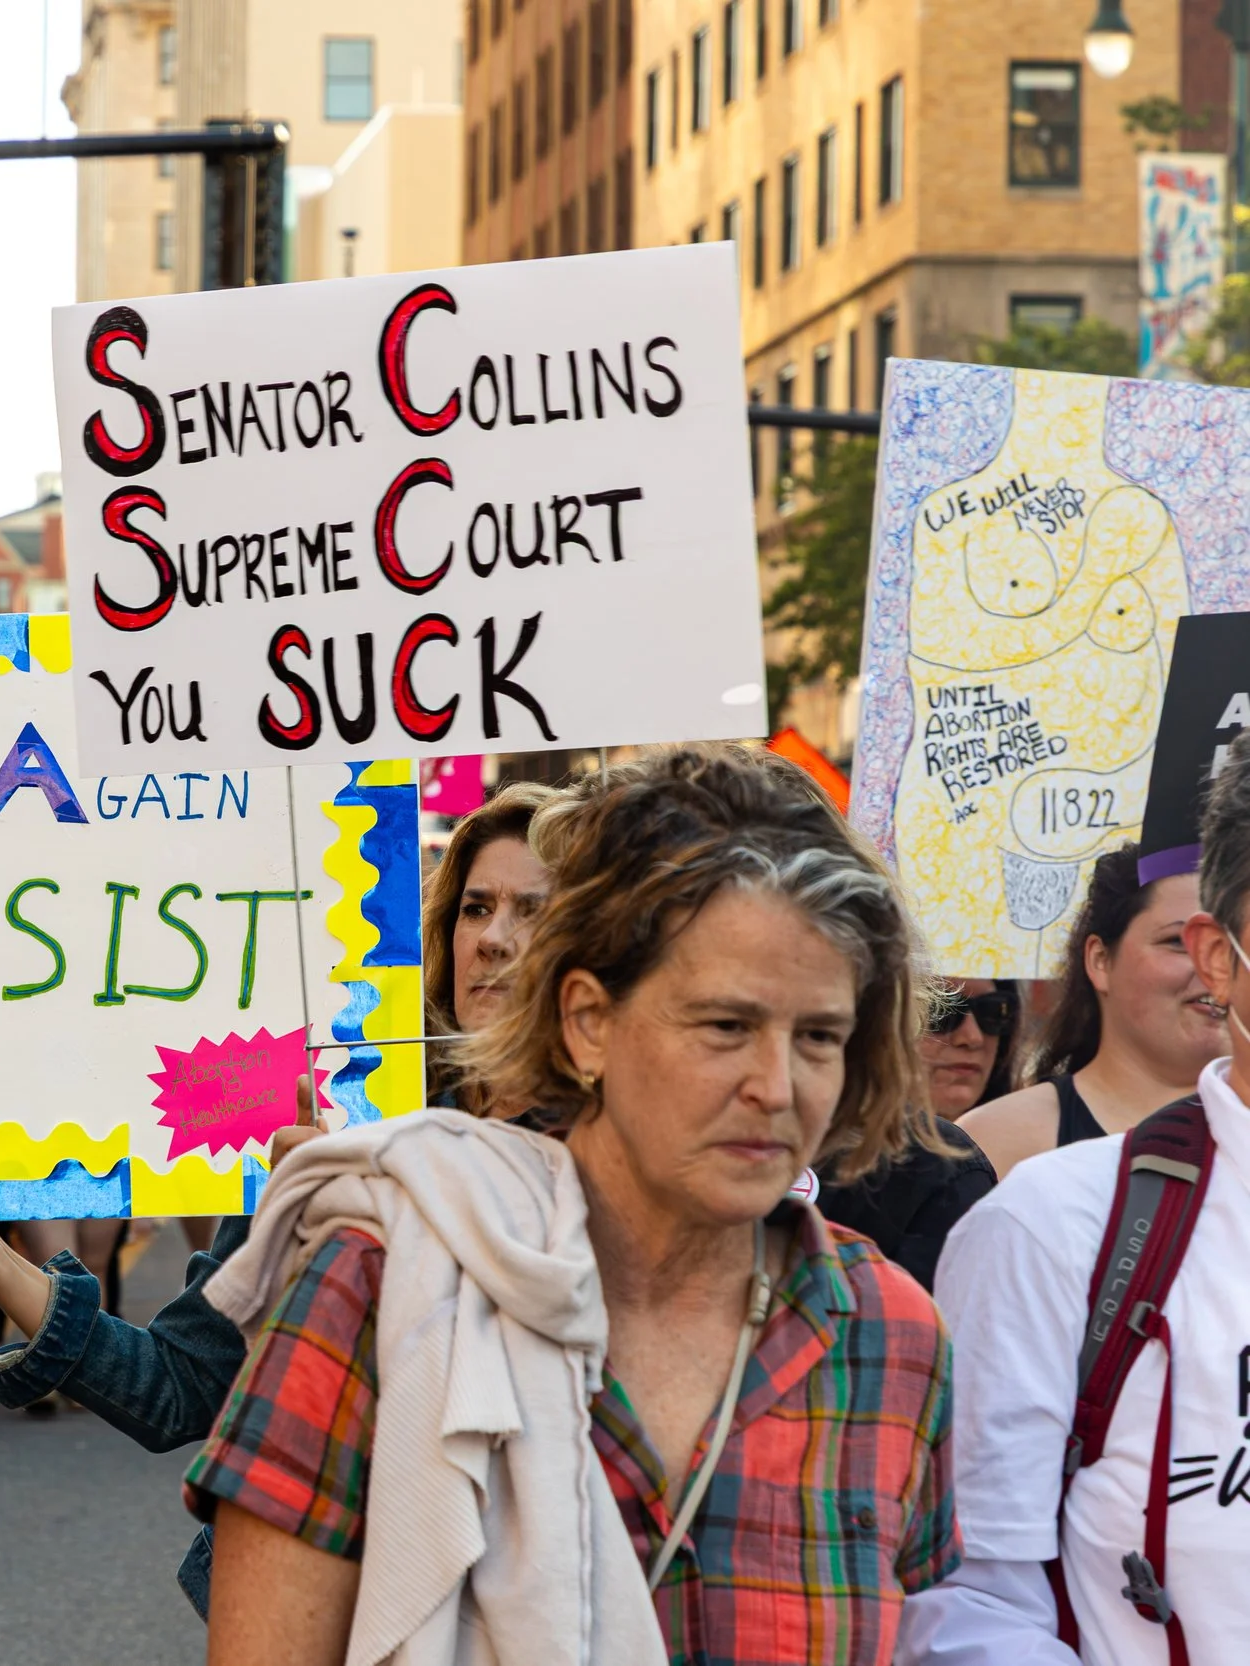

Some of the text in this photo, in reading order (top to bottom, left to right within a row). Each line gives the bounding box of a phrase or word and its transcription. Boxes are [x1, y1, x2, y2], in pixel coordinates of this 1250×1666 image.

[924, 472, 1039, 532] WE WILL
[1013, 477, 1075, 531] NEVER
[1037, 488, 1086, 534] STOP
[258, 611, 559, 751] SUCK
[926, 684, 1003, 709] UNTIL
[924, 697, 1031, 739] ABORTION
[997, 721, 1044, 752] ARE
[941, 735, 1068, 803] RESTORED
[171, 1049, 271, 1094] Abortion
